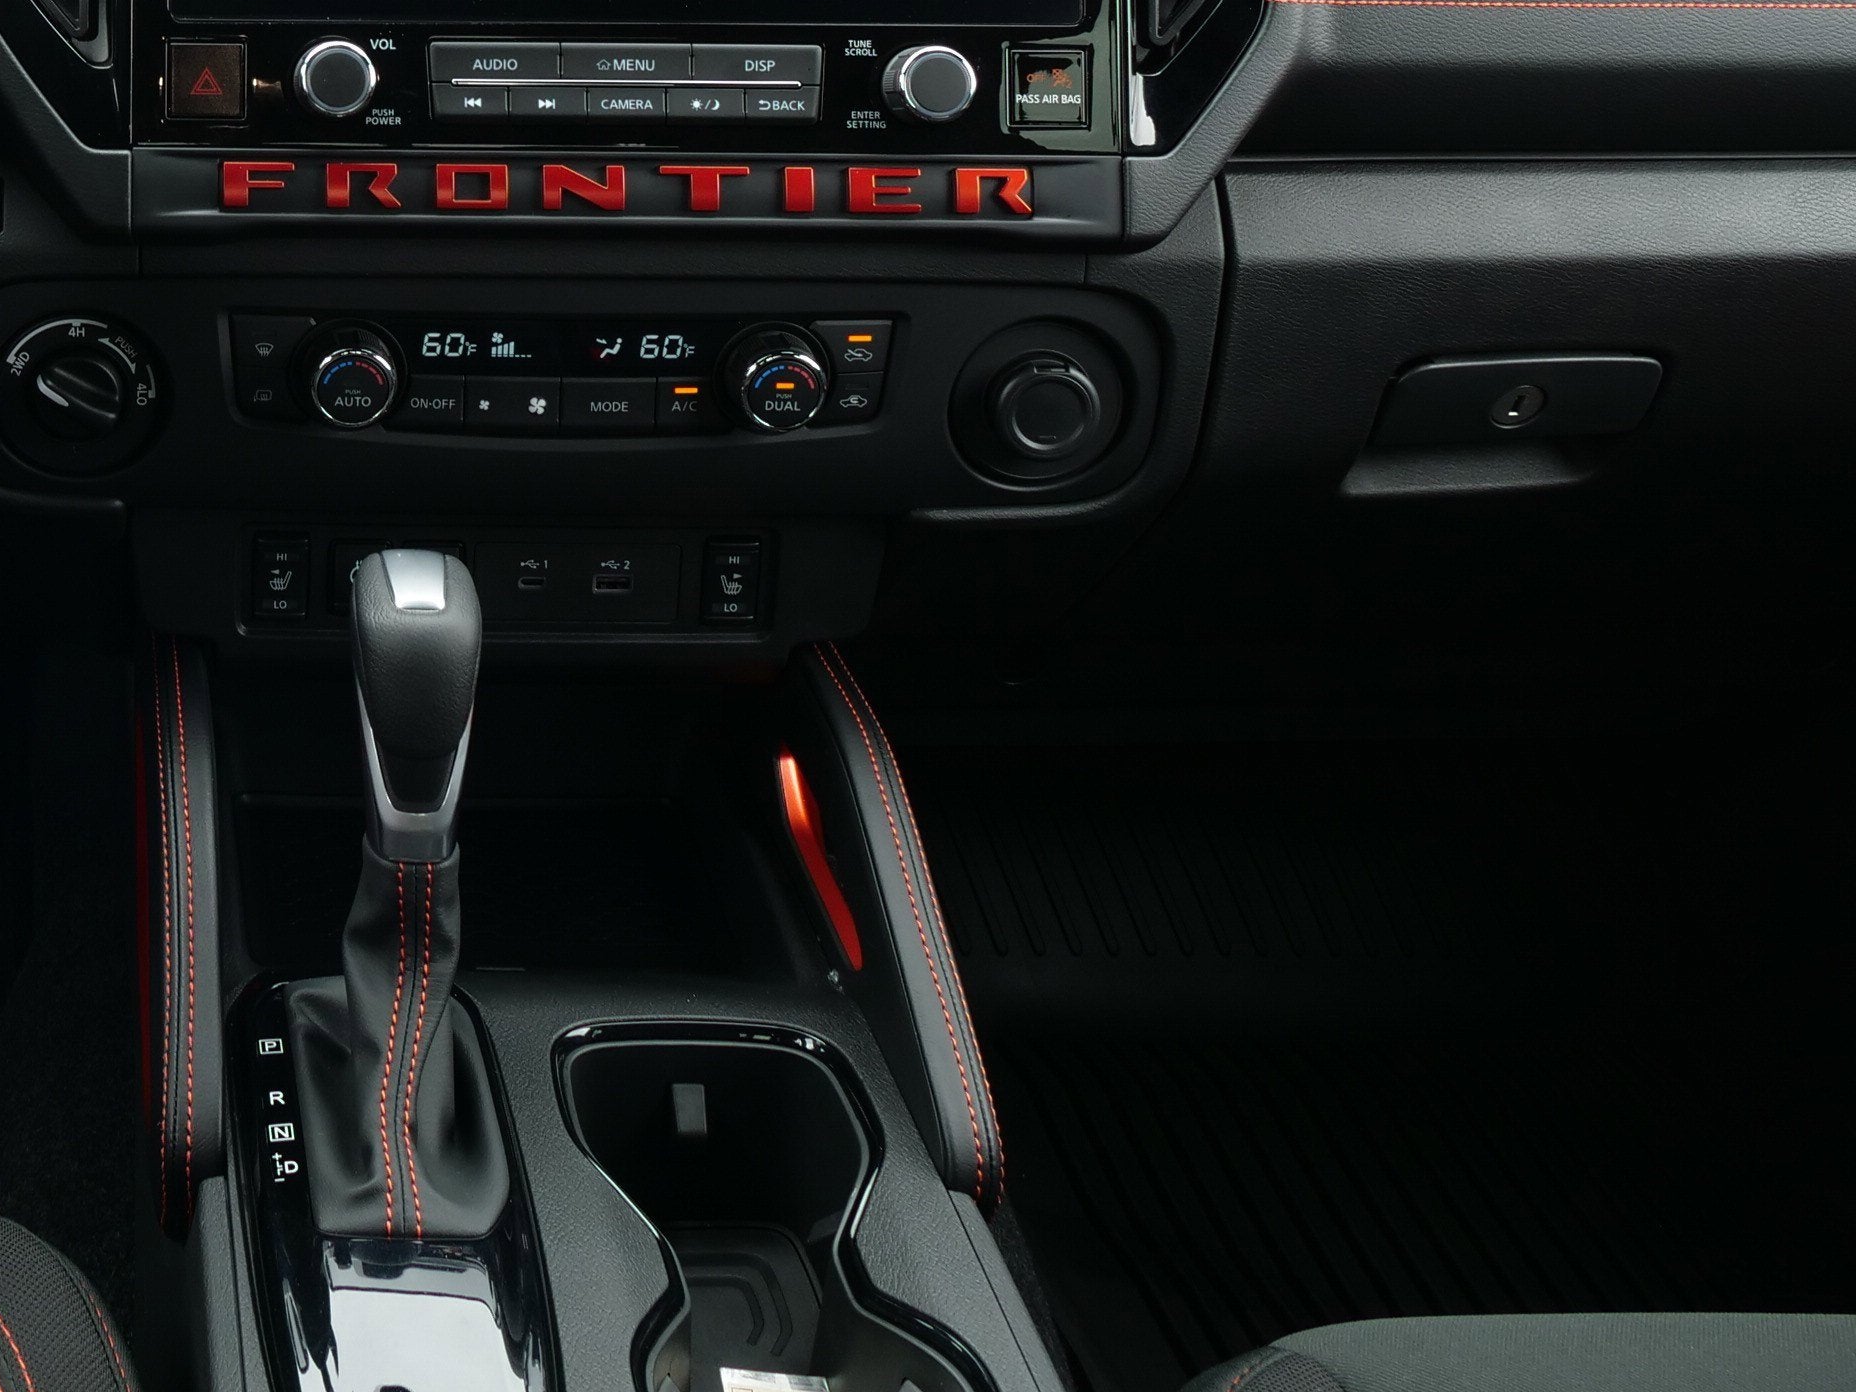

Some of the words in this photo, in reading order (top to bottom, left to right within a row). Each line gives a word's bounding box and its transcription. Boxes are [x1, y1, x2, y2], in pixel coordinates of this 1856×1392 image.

[370, 38, 396, 50] VOL
[848, 40, 872, 48] TUNE
[844, 48, 877, 57] SCROLL
[473, 59, 518, 71] AUDIO
[613, 59, 655, 71] MENU
[745, 60, 776, 72] DISP
[601, 99, 653, 110] CAMERA
[1016, 94, 1039, 104] PASS
[1042, 94, 1059, 104] AIR
[1061, 95, 1081, 104] BAG
[772, 100, 805, 111] BACK
[372, 109, 394, 117] PUSH
[851, 111, 880, 120] ENTER
[366, 117, 401, 125] POWER
[846, 120, 886, 129] SETTING
[218, 161, 1035, 215] FRONTIER
[68, 326, 85, 338] 4H
[114, 335, 138, 359] PUSH
[11, 351, 31, 377] 2WD
[136, 382, 147, 406] 4LO
[334, 396, 372, 408] AUTO
[590, 401, 629, 413] MODE
[672, 401, 697, 413] A/C
[765, 400, 801, 412] DUAL
[276, 553, 287, 561] HI
[729, 556, 740, 564] HI
[624, 560, 630, 569] 2
[273, 601, 287, 610] LO
[724, 604, 738, 613] LO
[265, 1041, 277, 1052] P
[269, 1091, 285, 1106] R
[274, 1126, 289, 1139] N
[284, 1161, 299, 1174] D
